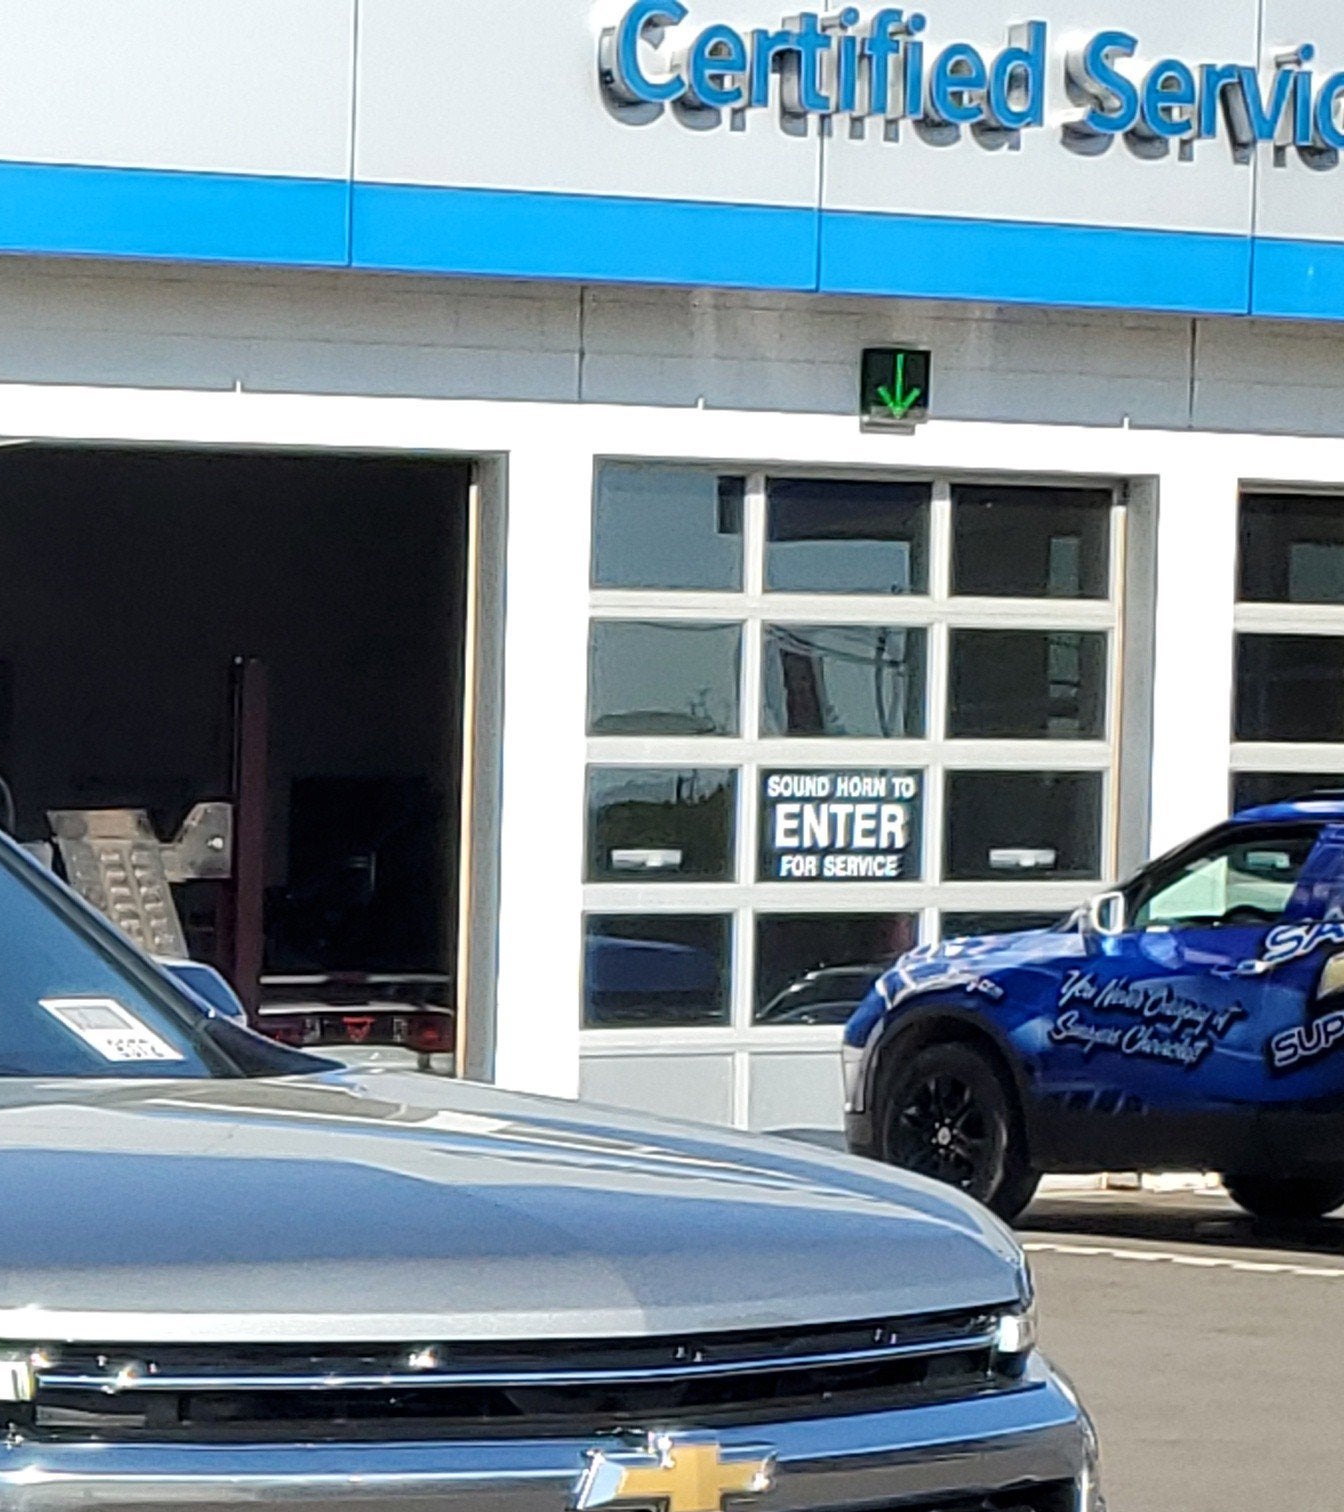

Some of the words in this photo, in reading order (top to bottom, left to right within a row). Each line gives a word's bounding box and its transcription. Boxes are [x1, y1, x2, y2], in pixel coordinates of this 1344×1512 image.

[613, 0, 1048, 129] Certified
[767, 775, 830, 797] SOUND
[835, 776, 886, 797] HORN
[892, 776, 917, 798] TO
[774, 803, 908, 848] ENTER
[779, 855, 817, 876] FOR
[823, 855, 901, 877] SERVICE
